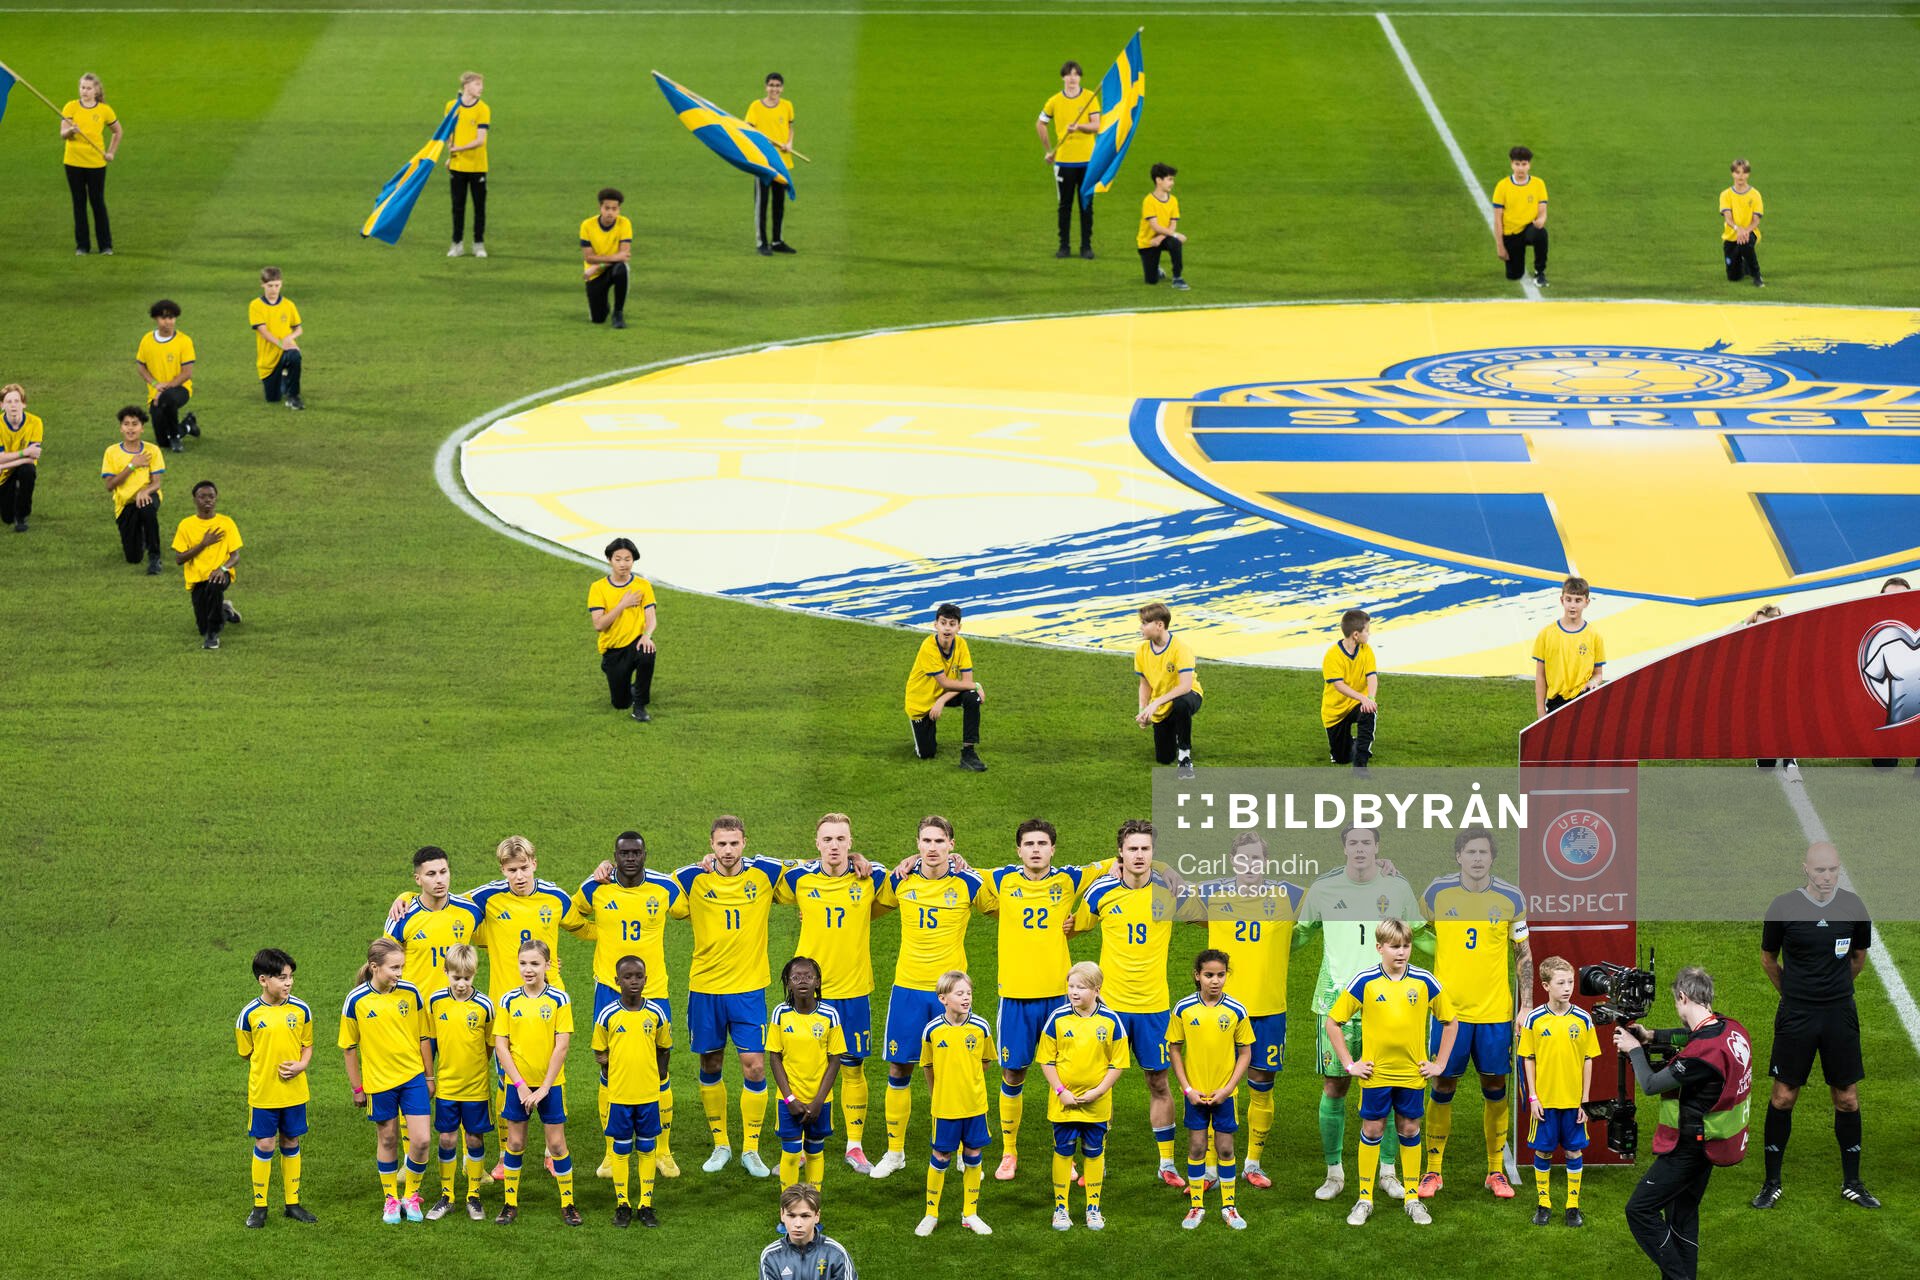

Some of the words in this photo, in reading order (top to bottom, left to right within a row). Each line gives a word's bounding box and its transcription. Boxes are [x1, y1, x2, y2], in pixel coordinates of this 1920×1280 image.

[1289, 409, 1920, 427] SVERIGE
[1557, 814, 1600, 830] UEFA
[1530, 892, 1629, 913] RESPECT
[724, 909, 741, 930] 11
[825, 907, 846, 928] 17
[918, 907, 938, 929] 15
[1022, 907, 1048, 929] 22
[621, 919, 641, 941] 13
[1127, 923, 1147, 944] 19
[1235, 921, 1261, 942] 20
[1359, 923, 1366, 945] 1
[1465, 928, 1477, 950] 3
[853, 1030, 871, 1052] 17
